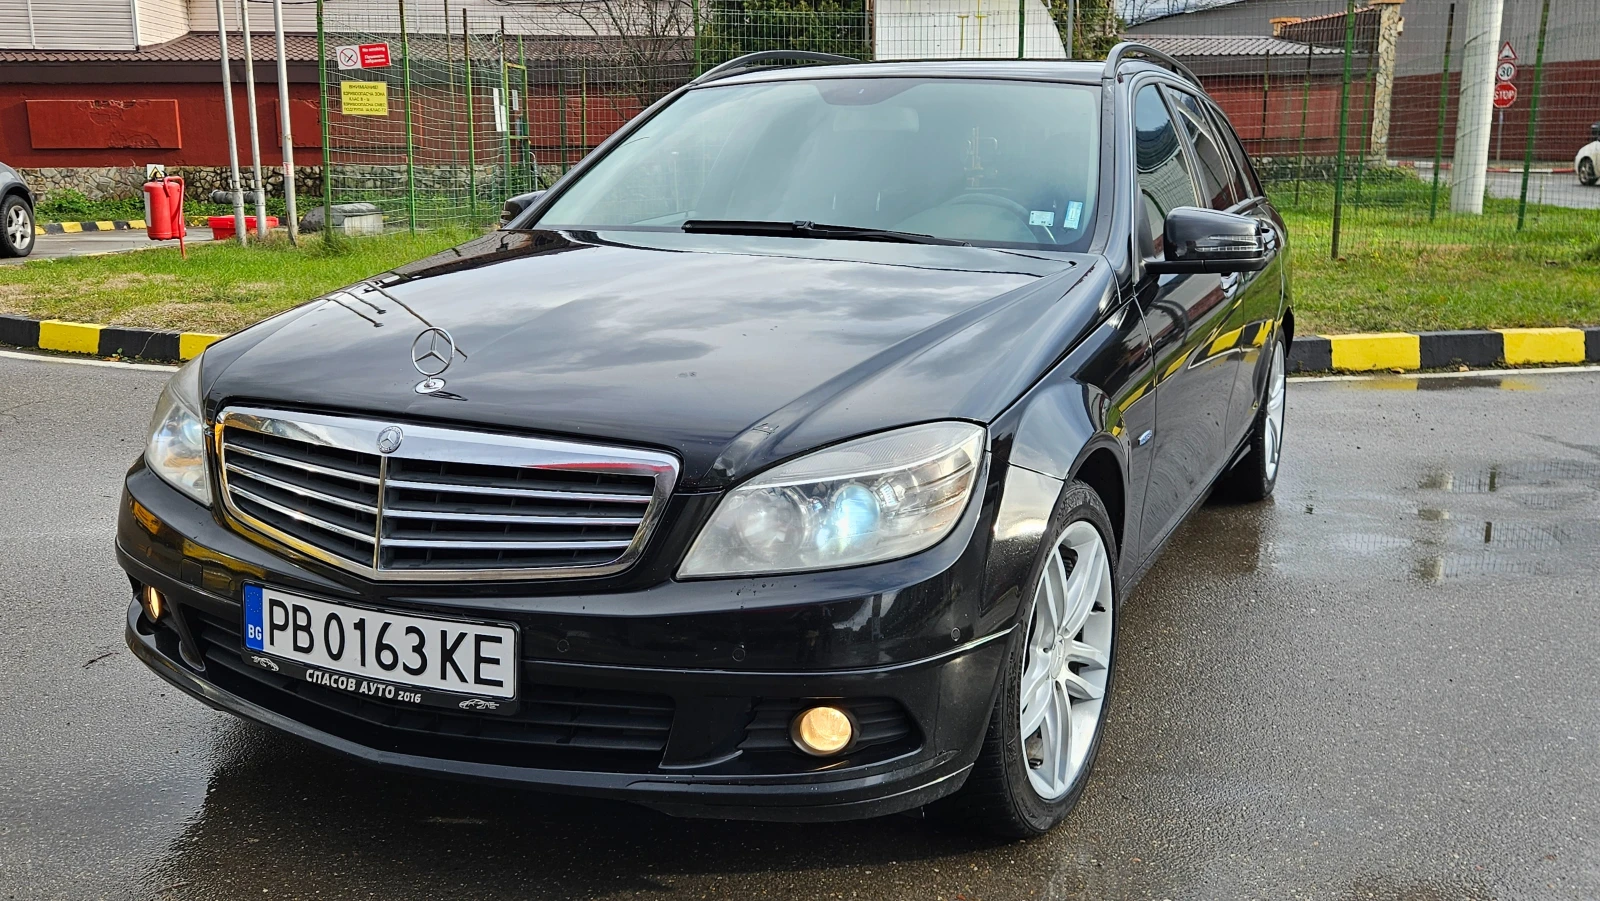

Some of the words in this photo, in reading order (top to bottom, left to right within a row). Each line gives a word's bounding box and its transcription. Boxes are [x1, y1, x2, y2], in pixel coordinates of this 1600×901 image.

[1500, 66, 1512, 77] 30
[1494, 90, 1514, 100] STOP
[248, 624, 262, 641] BG
[305, 670, 356, 692] СПАСОВ
[358, 682, 396, 699] АУТО
[398, 691, 422, 704] 2016
